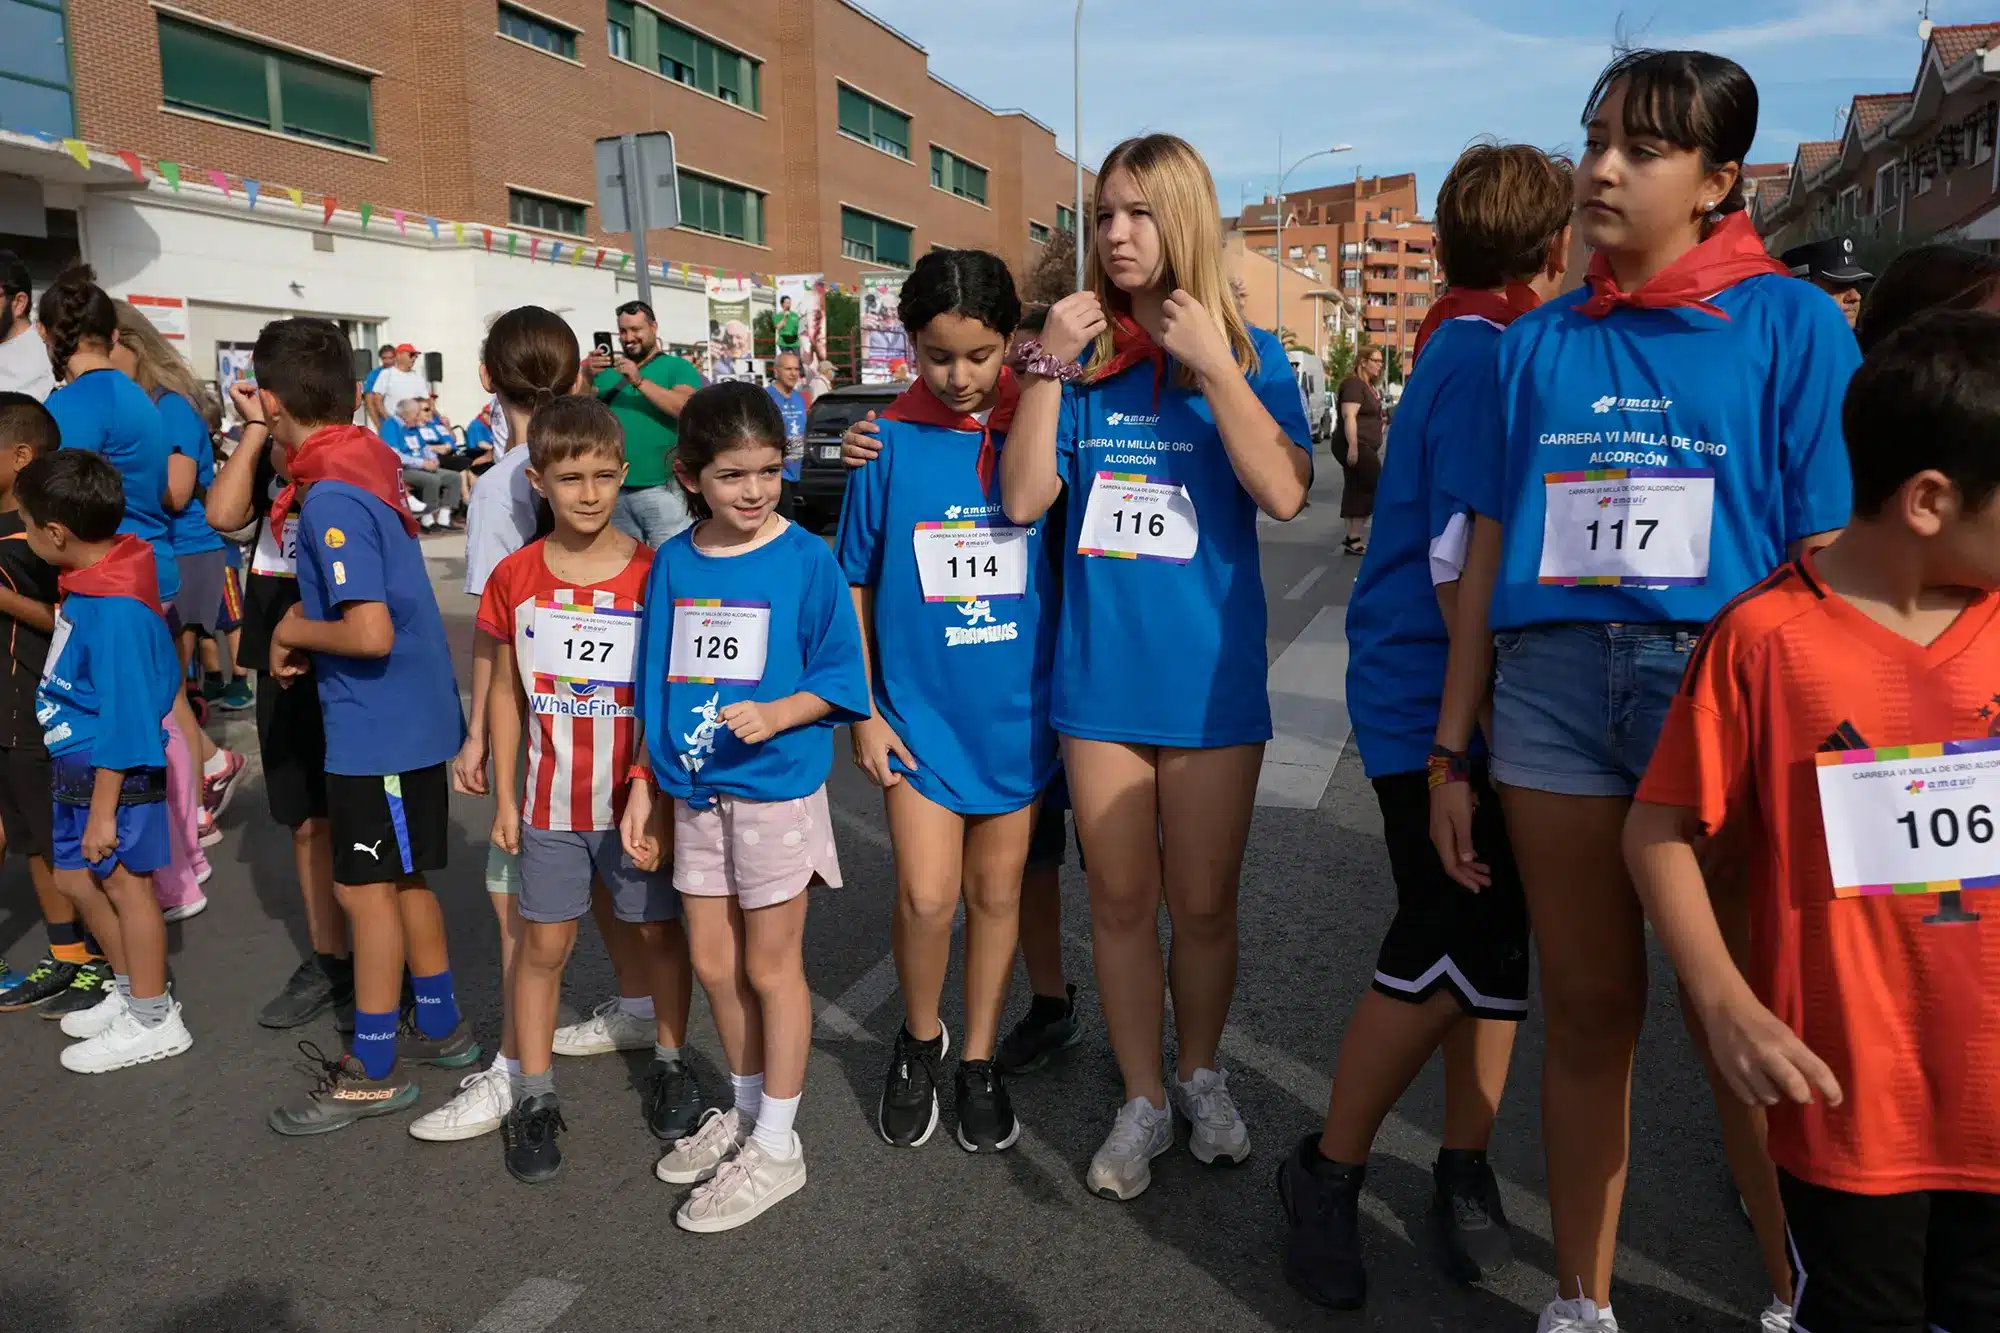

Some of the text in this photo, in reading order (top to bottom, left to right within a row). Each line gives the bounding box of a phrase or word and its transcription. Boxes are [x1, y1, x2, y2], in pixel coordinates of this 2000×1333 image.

[1618, 396, 1672, 409] amavir
[1124, 414, 1160, 423] amavir
[1116, 440, 1125, 449] VI
[1127, 440, 1156, 450] MILLA
[1158, 442, 1169, 451] DE
[1172, 442, 1194, 452] ORO
[1540, 432, 1727, 457] CARRERA VI MILLA DE ORO
[1105, 454, 1156, 465] ALCORCÓN
[1589, 451, 1668, 467] ALCORCÓN
[1613, 495, 1647, 504] amavir
[963, 503, 1001, 514] amavir
[1113, 510, 1165, 537] 116
[1586, 519, 1659, 550] 117
[947, 556, 998, 578] 114
[563, 639, 614, 663] 127
[694, 636, 739, 660] 126
[1852, 770, 1896, 780] CARRERA
[1898, 768, 1907, 776] VI
[1909, 766, 1937, 775] MILLA
[1939, 765, 1951, 773] DE
[1953, 763, 1973, 771] ORO
[1928, 776, 1977, 788] amavir
[1897, 804, 1994, 849] 106
[358, 1031, 397, 1041] adidas
